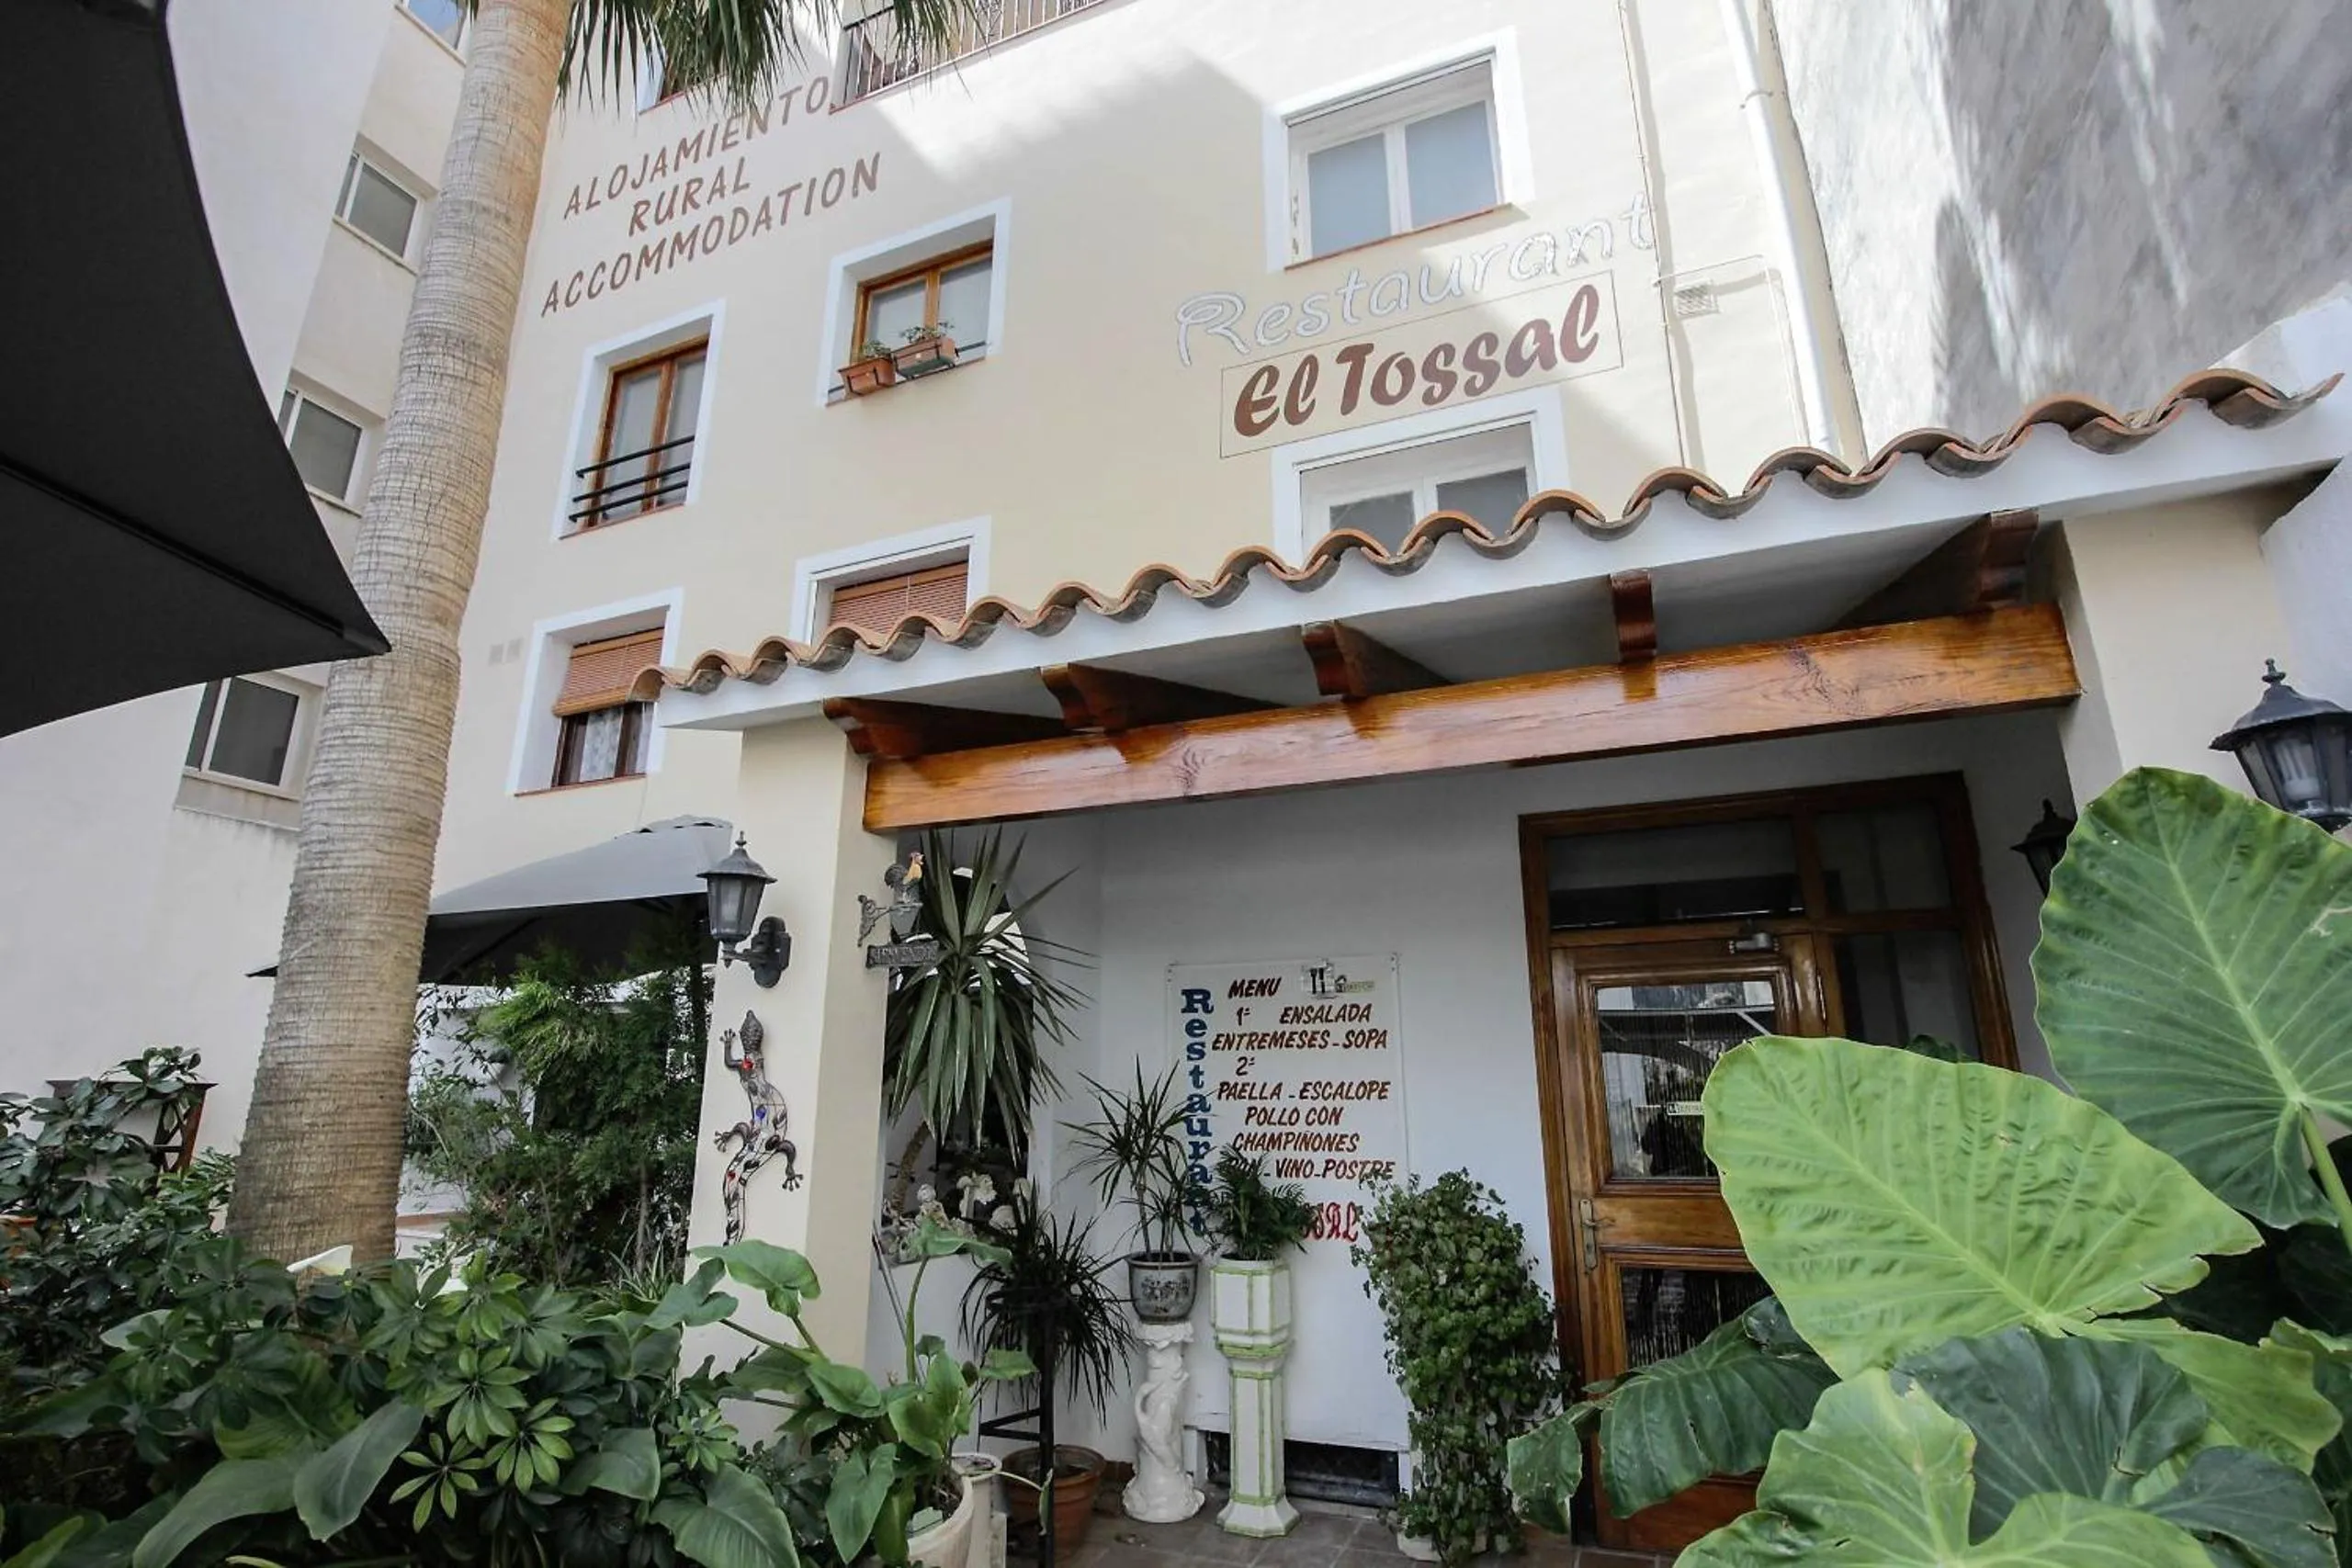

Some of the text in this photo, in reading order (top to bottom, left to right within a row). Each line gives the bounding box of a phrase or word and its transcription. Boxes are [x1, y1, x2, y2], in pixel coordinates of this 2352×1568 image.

[563, 76, 830, 221] ALOJAMIENTO
[628, 156, 752, 237] RURAL
[540, 152, 882, 318] ACCOMMODATION
[1175, 192, 1654, 367] Restaurant
[1233, 283, 1600, 438] El Tossal
[1228, 977, 1282, 998] MENU
[1280, 1003, 1373, 1024] ENSALADA
[1212, 1030, 1329, 1051] ENTREMESES
[1342, 1030, 1387, 1049] SOPA
[1216, 1080, 1283, 1101] PAELLA
[1298, 1080, 1391, 1101] ESCALOPE
[1244, 1105, 1344, 1127] POLLO CON
